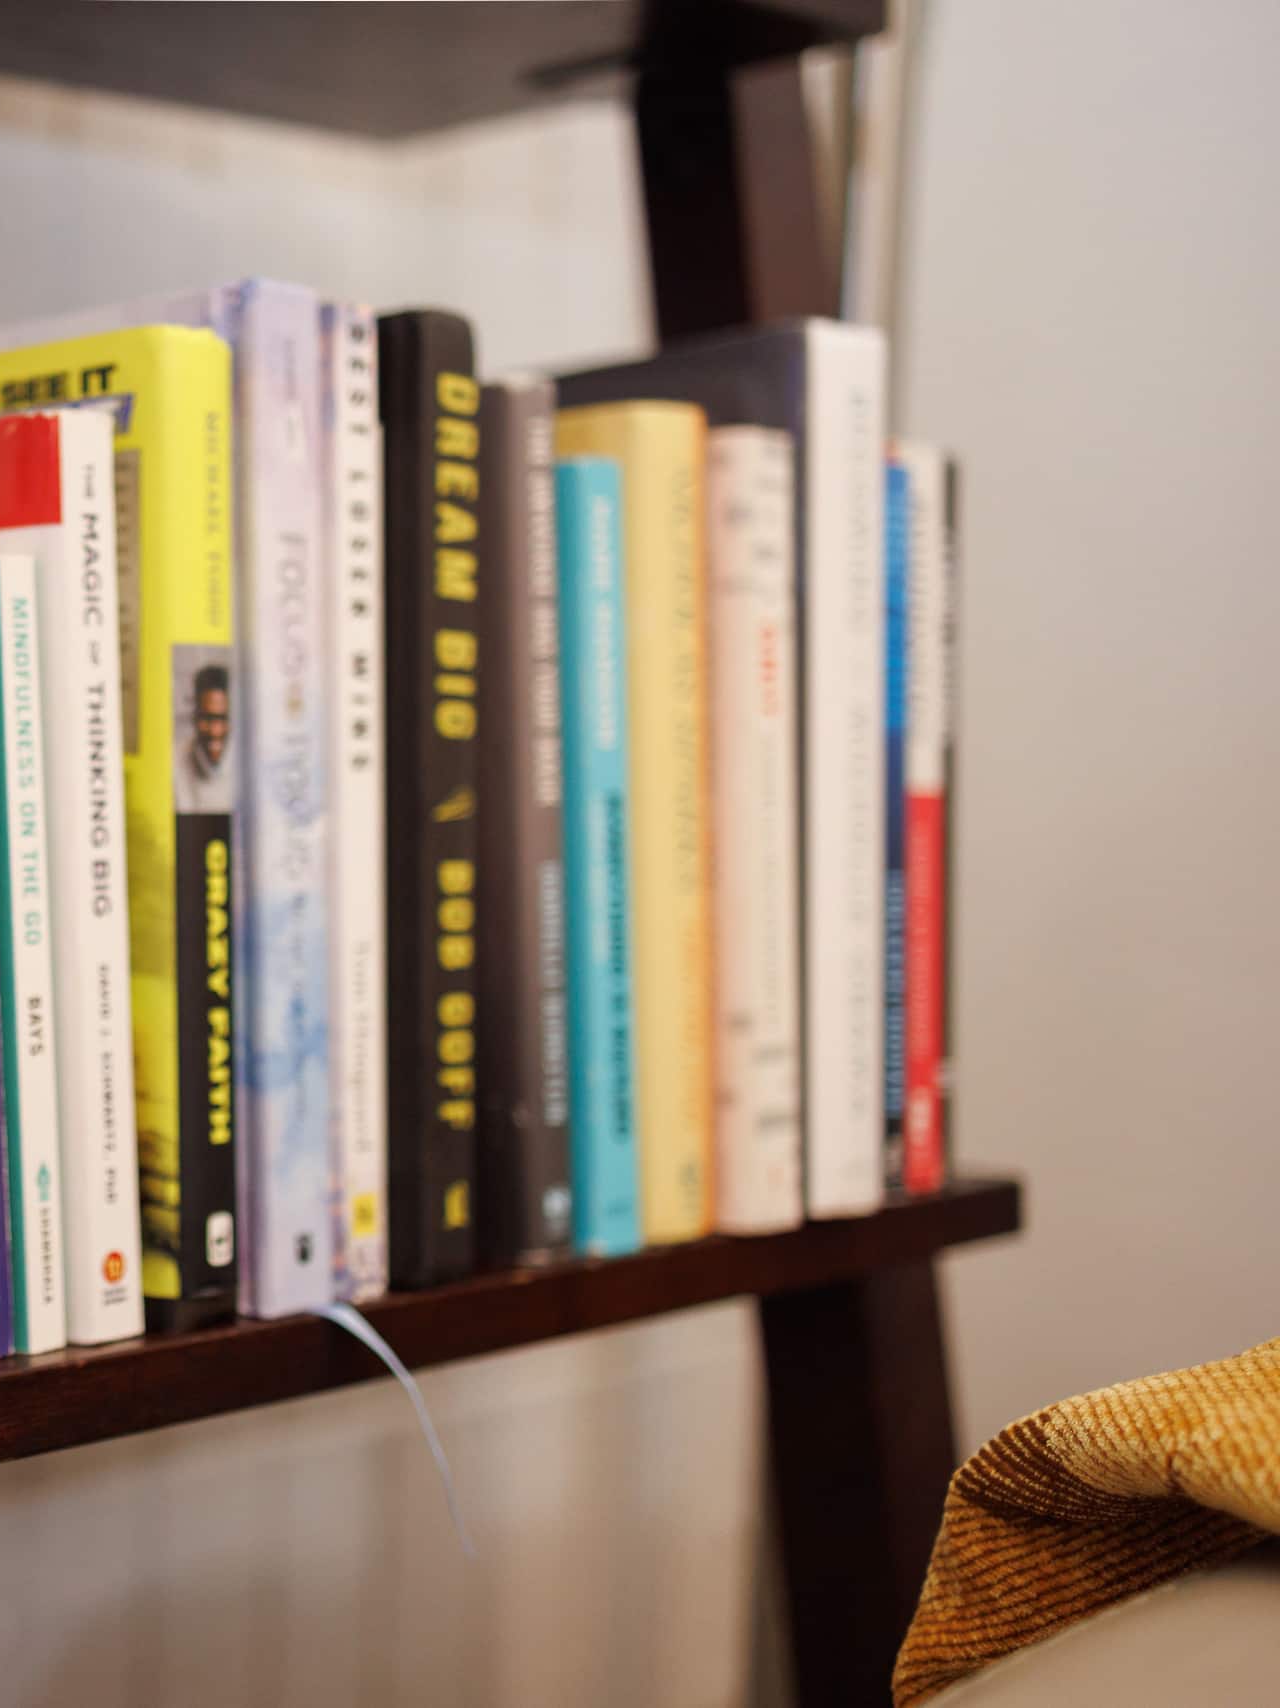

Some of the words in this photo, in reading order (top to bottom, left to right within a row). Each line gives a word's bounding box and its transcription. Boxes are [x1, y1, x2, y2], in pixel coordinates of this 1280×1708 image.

[1, 372, 69, 406] SEE
[81, 364, 117, 393] IT
[434, 370, 481, 603] DREAM
[81, 512, 104, 627] MAGIC
[14, 597, 35, 789] MINDFULNESS
[434, 628, 479, 740] BIG
[19, 801, 37, 837] ON
[86, 682, 111, 849] THINKING
[21, 849, 40, 896] THE
[24, 911, 42, 946] GO
[92, 859, 113, 918] BIG
[205, 838, 231, 999] CRAZY
[437, 858, 476, 970] BOB
[27, 995, 46, 1057] BAYS
[207, 1006, 233, 1145] FAITH
[437, 991, 477, 1130] GOFF
